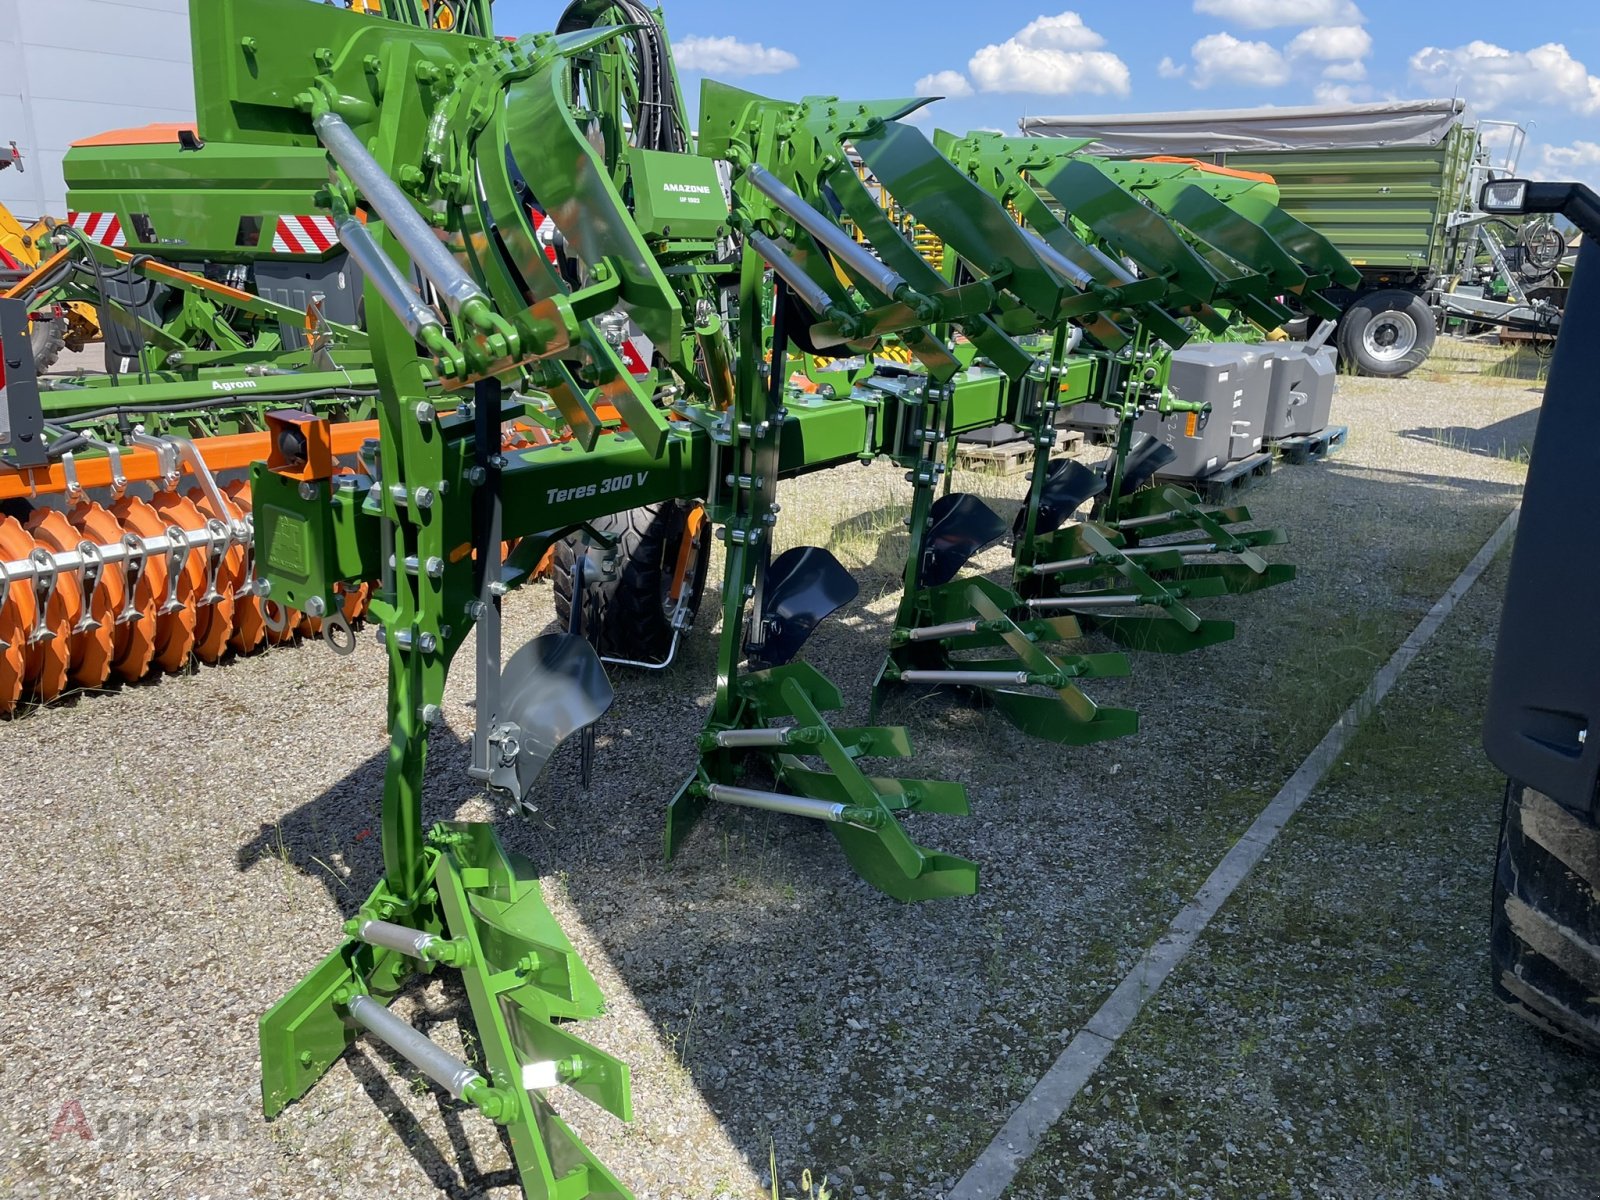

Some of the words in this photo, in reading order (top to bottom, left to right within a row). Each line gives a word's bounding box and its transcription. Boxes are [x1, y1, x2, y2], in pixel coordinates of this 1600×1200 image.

[663, 183, 710, 194] AMAZONE
[212, 380, 256, 391] Agrom
[547, 488, 597, 504] Teres
[600, 474, 633, 494] 300
[637, 470, 649, 486] V
